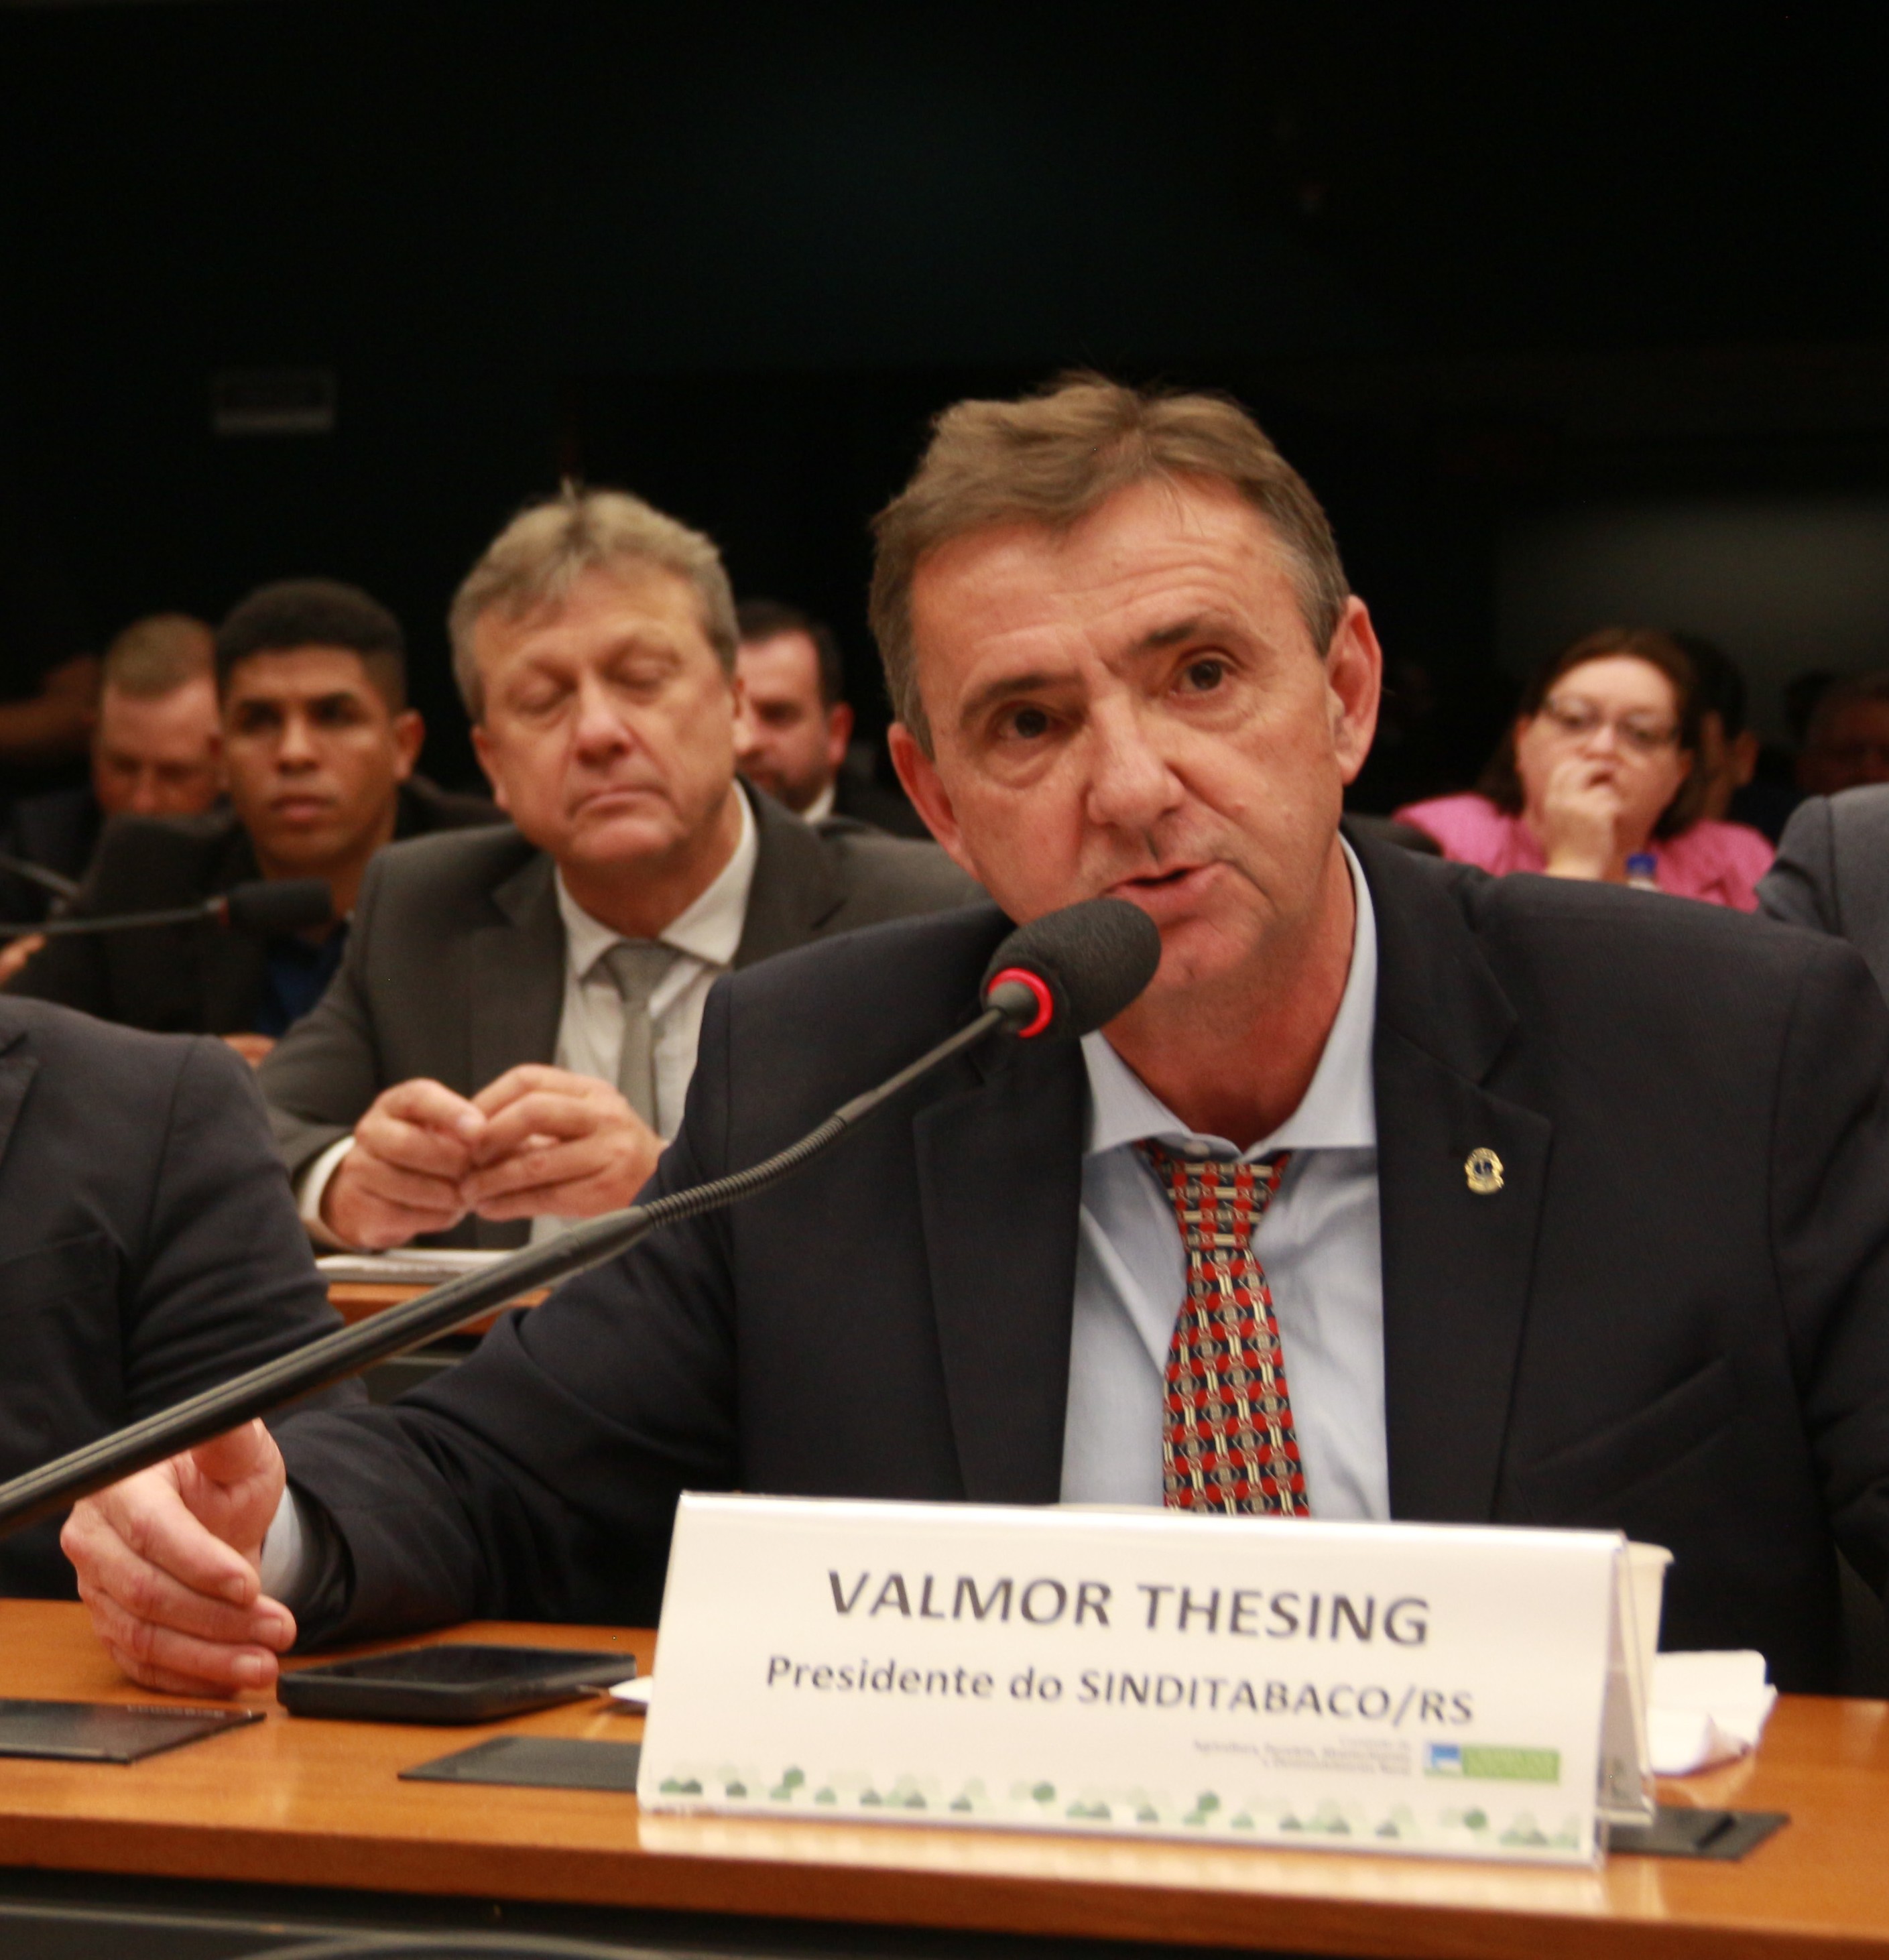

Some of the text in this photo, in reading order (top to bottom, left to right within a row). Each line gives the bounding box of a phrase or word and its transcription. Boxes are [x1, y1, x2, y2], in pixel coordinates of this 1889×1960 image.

[827, 1570, 1430, 1647] VALMOR THESING
[766, 1656, 1475, 1729] Presidente do SINDITABACO/RS
